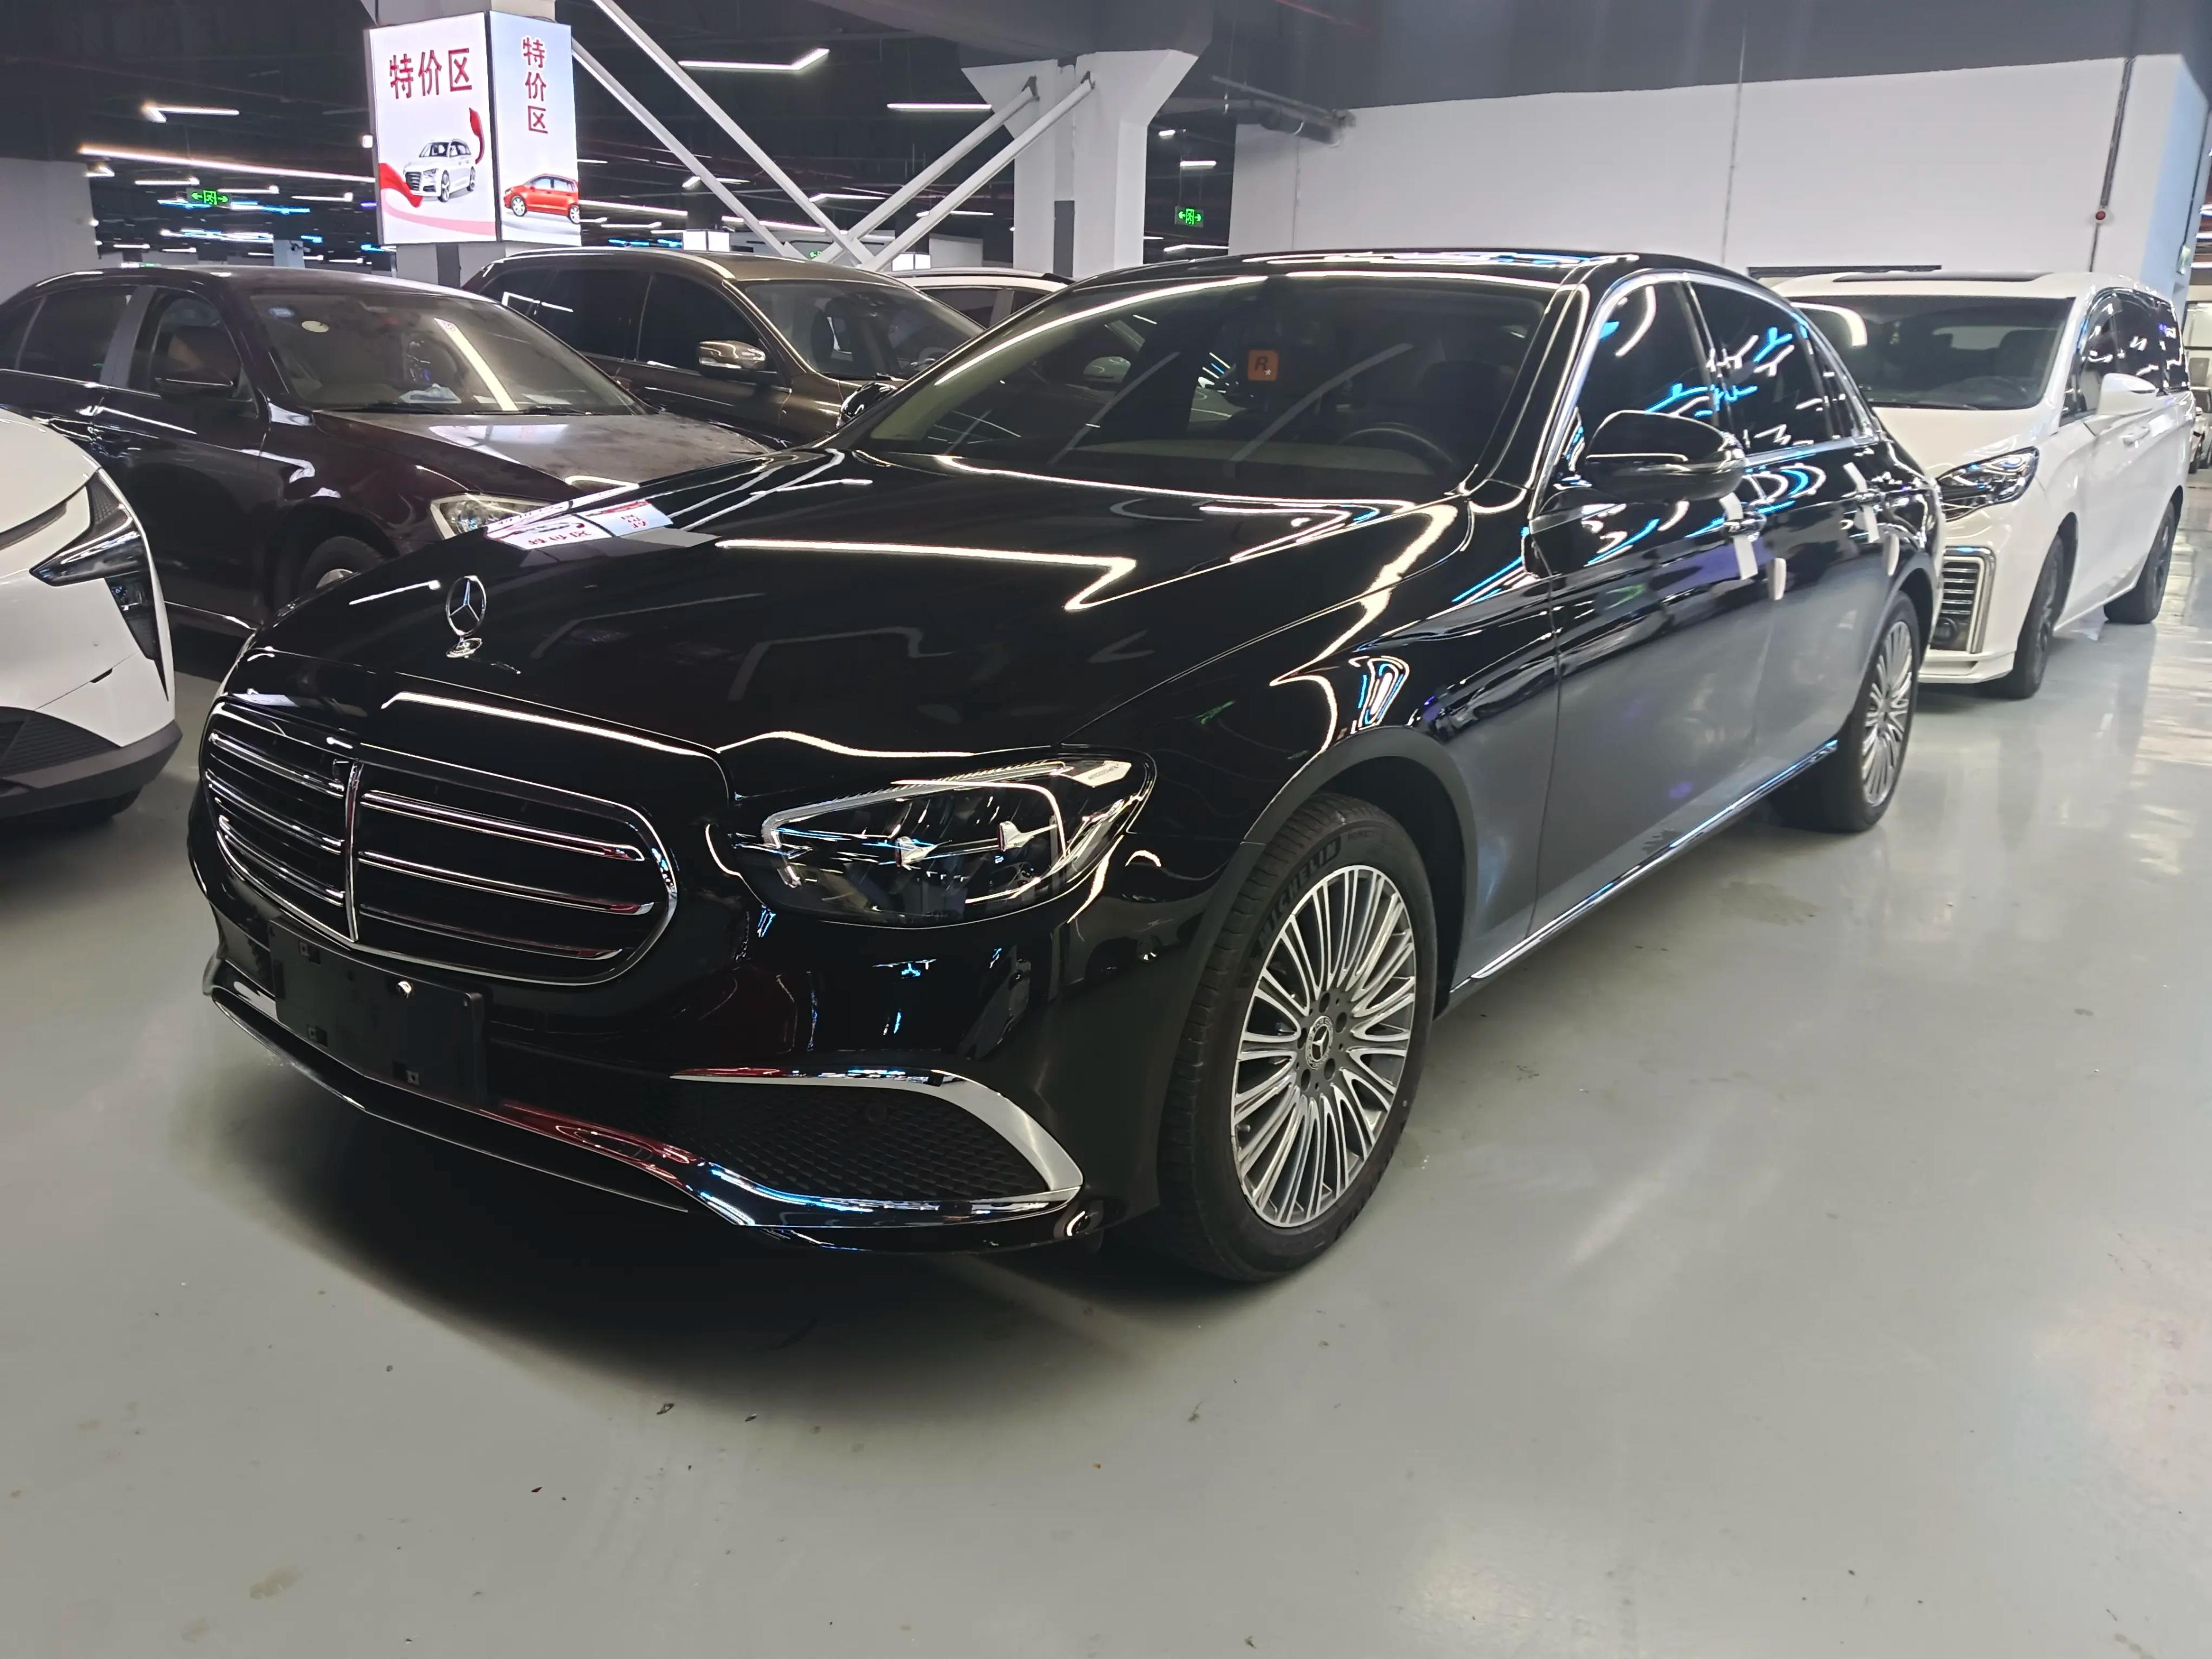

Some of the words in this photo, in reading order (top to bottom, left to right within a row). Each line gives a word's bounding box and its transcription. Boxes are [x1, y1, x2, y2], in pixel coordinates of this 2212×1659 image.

[389, 48, 472, 99] 特价区
[522, 37, 548, 134] 特价区
[1257, 839, 1336, 949] MICHELIN
